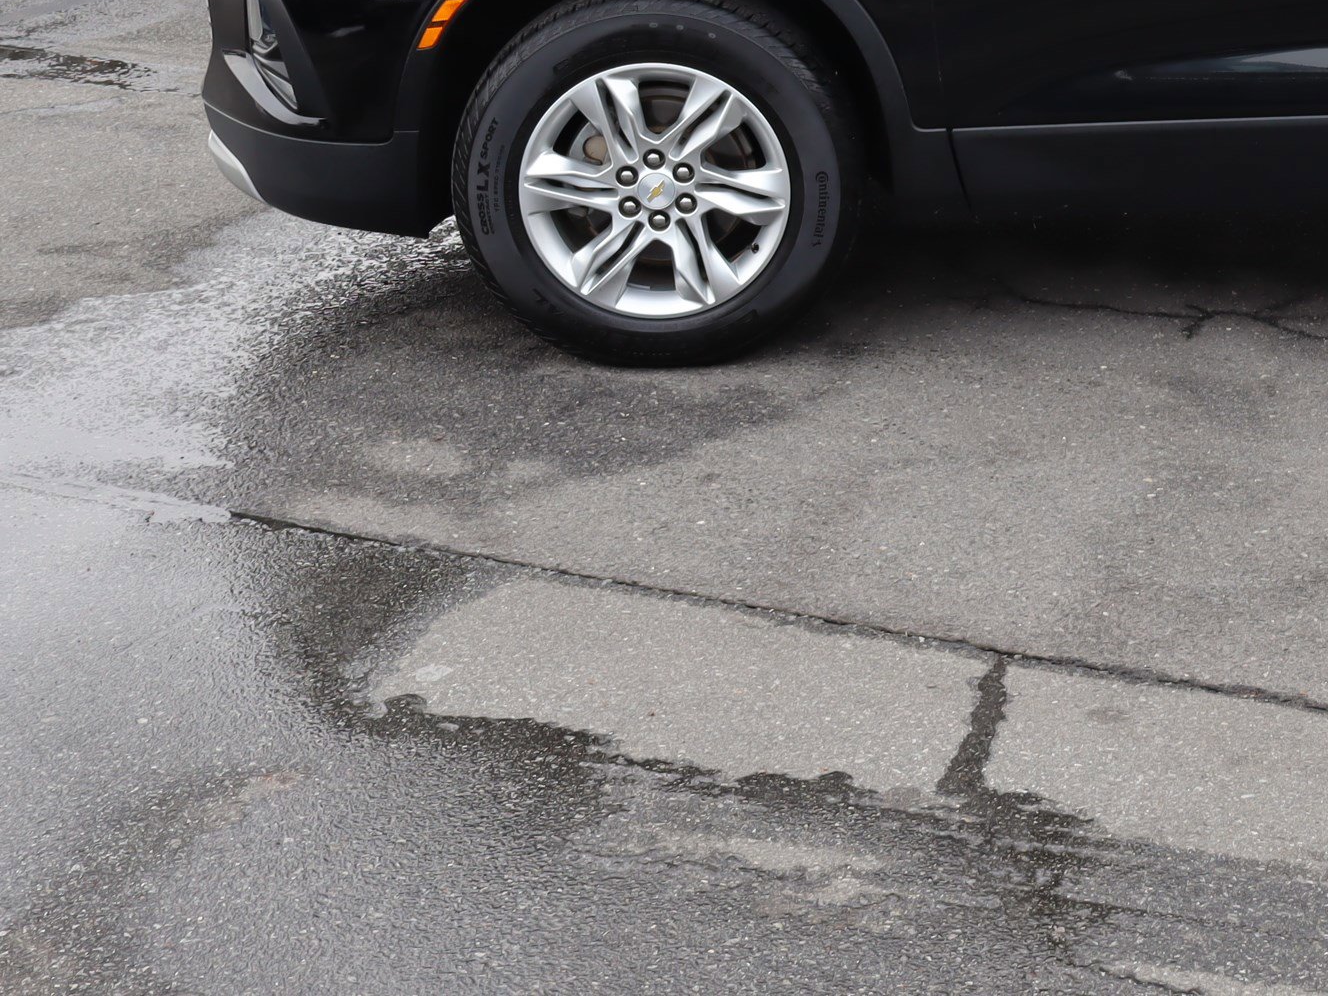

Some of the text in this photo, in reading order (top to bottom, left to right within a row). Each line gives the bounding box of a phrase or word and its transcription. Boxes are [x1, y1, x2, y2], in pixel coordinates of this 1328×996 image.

[476, 117, 499, 236] CROSS LX SPORT
[813, 170, 830, 238] Continental
